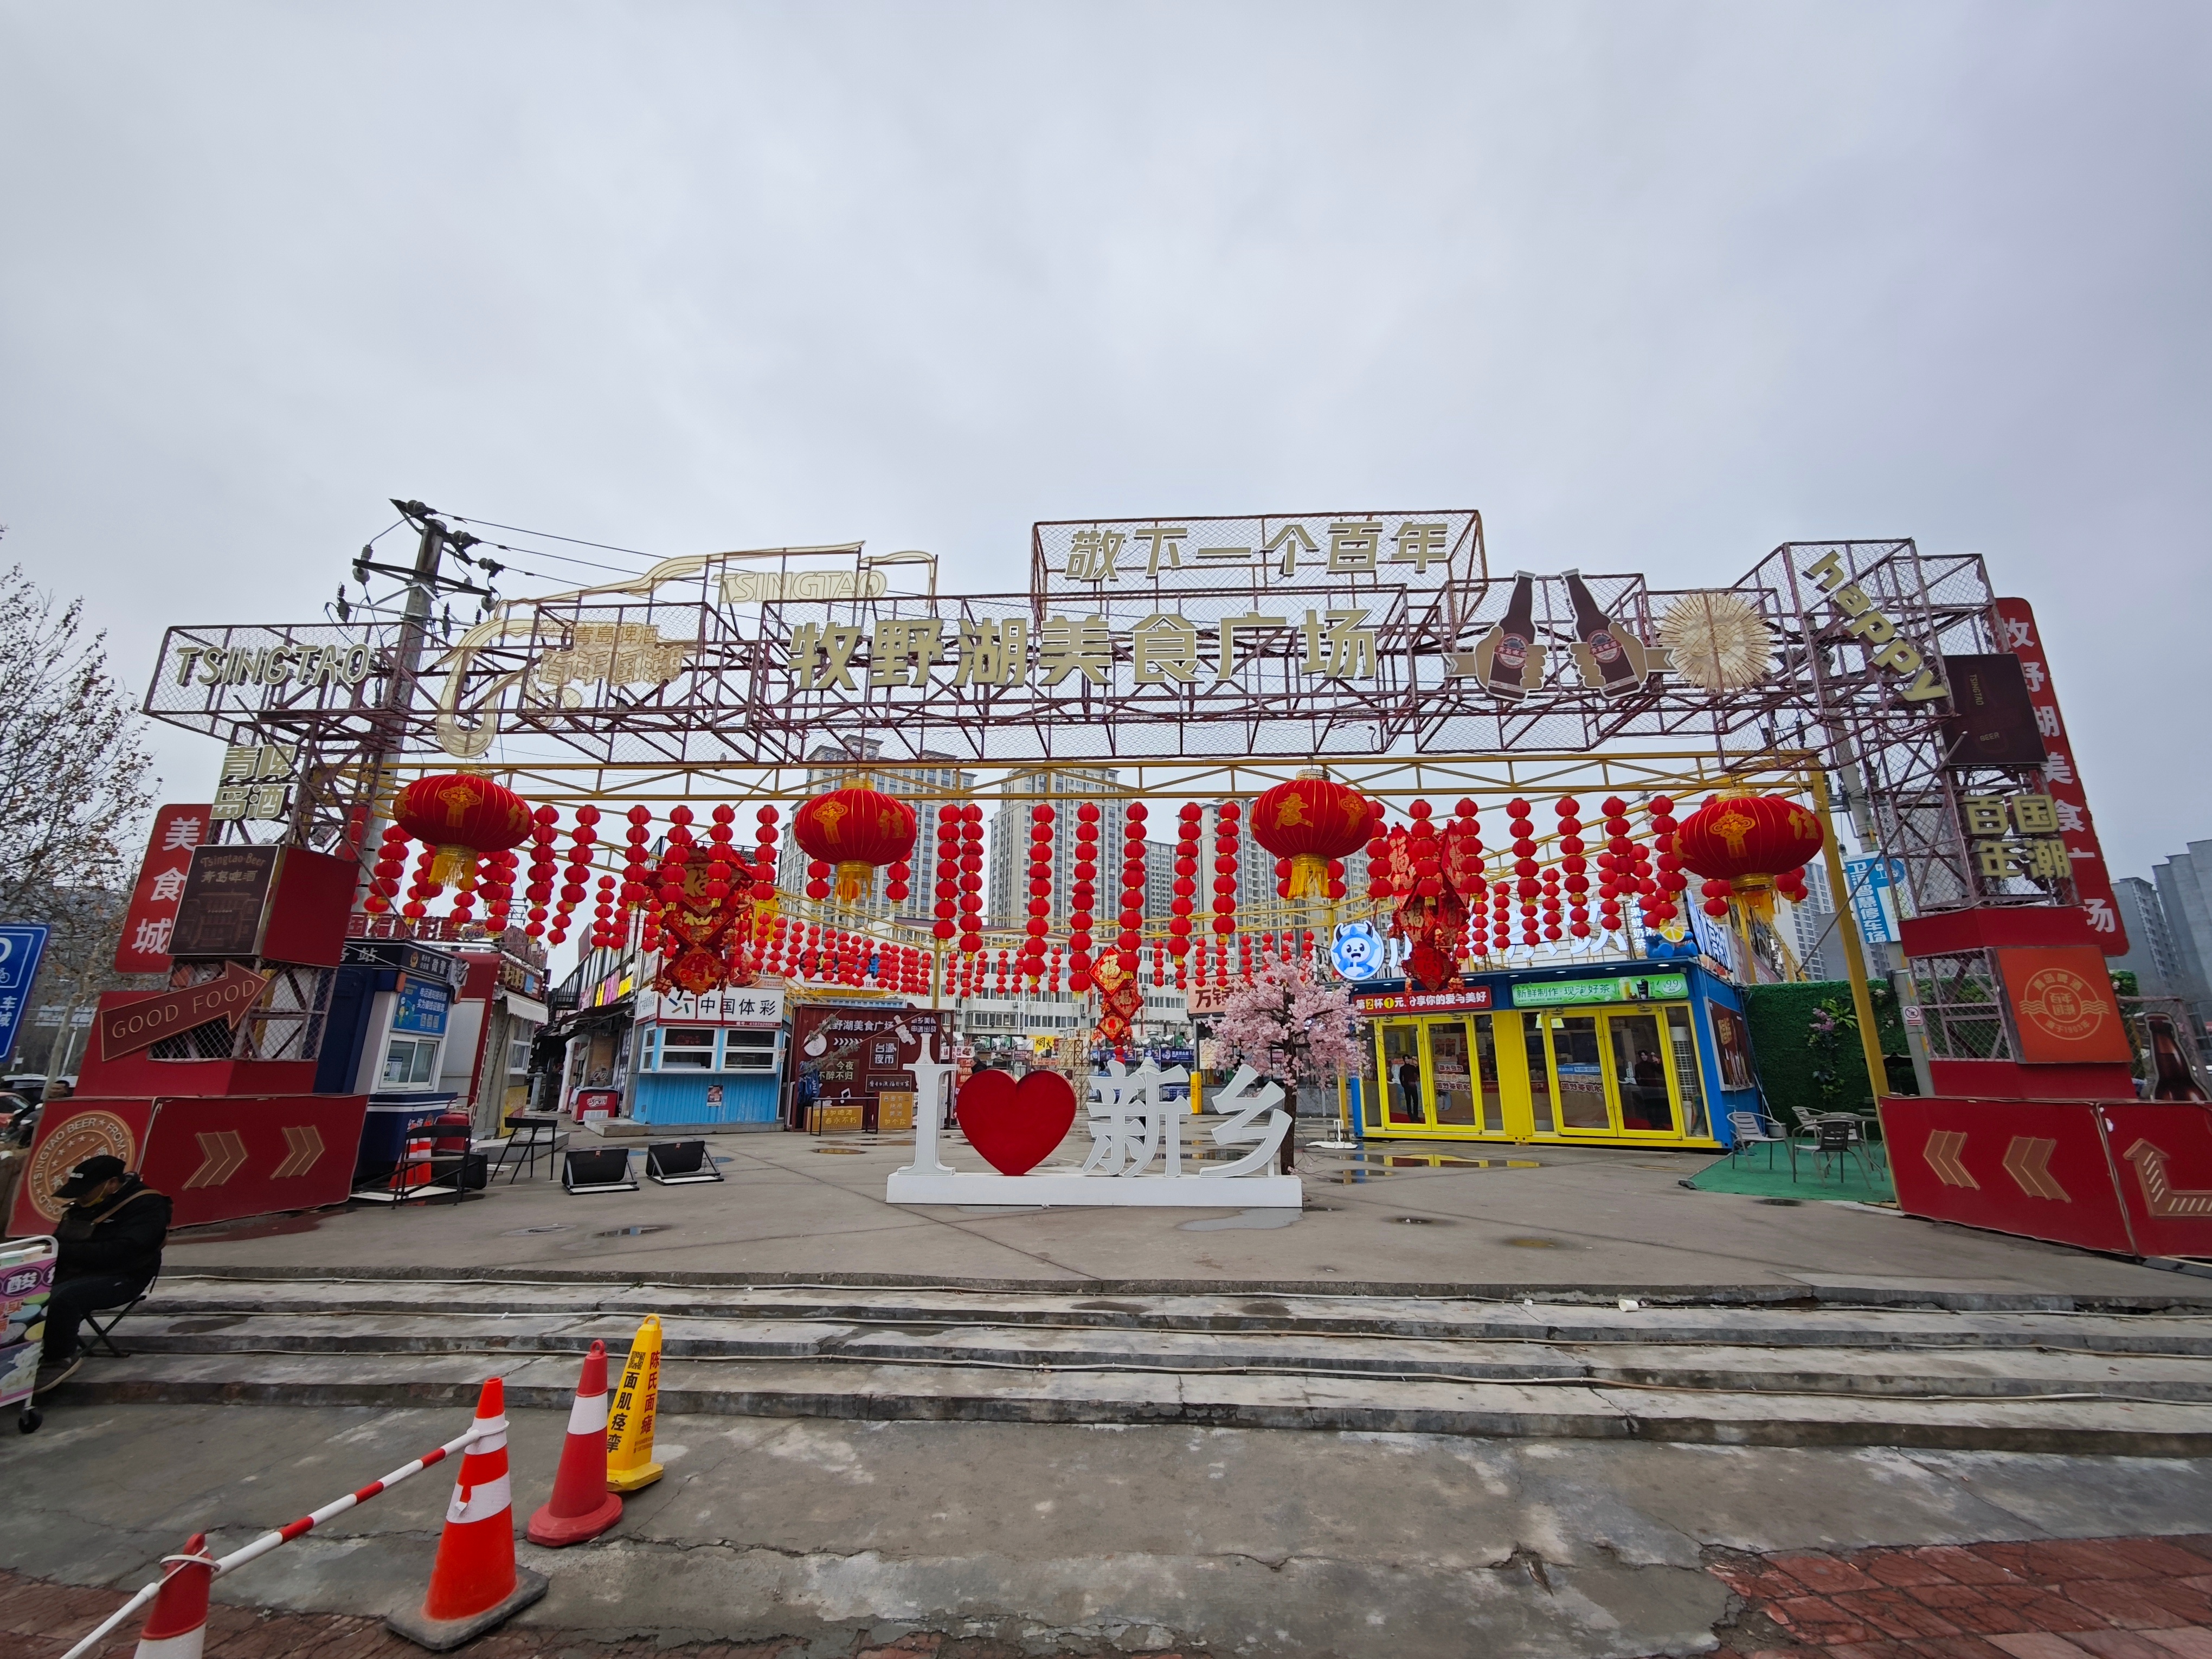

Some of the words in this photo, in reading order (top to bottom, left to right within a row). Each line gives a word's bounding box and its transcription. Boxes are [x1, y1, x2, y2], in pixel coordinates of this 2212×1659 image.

[1065, 522, 1449, 581] 敬下一个百年
[711, 570, 888, 603] TSINGTAO
[574, 625, 659, 646] 青岛啤酒
[1803, 550, 1949, 702] happy
[176, 643, 373, 686] TSINGTAO
[539, 646, 685, 686] 百年国潮
[788, 609, 1377, 690] 牧野湖美食广场
[1969, 674, 1984, 705] TSINGTAO
[1979, 732, 2000, 742] BEER
[200, 854, 243, 867] Tsingtao
[246, 852, 266, 867] Beer
[201, 870, 259, 883] 青岛啤酒
[132, 817, 201, 954] 美食城
[1848, 862, 1887, 943] 卫河智慧停车场
[1629, 897, 1647, 949] 水果鲜奶茶
[112, 1005, 179, 1039] GOOD
[192, 980, 256, 1014] FOOD
[700, 996, 776, 1017] 中国体彩
[837, 1061, 854, 1071] 今夜
[874, 1054, 894, 1064] 夜市
[875, 1043, 897, 1053] 台源
[818, 1071, 853, 1081] 不醉不归
[106, 1123, 127, 1150] FROM
[816, 1117, 857, 1125] 春永不朽
[897, 1063, 958, 1176] I
[1083, 1060, 1294, 1178] 新乡
[34, 1131, 65, 1187] TSINGTAO
[67, 1117, 97, 1134] BEER
[640, 1351, 660, 1436] 陈氏面瘫
[607, 1371, 640, 1454] 面肌痉挛
